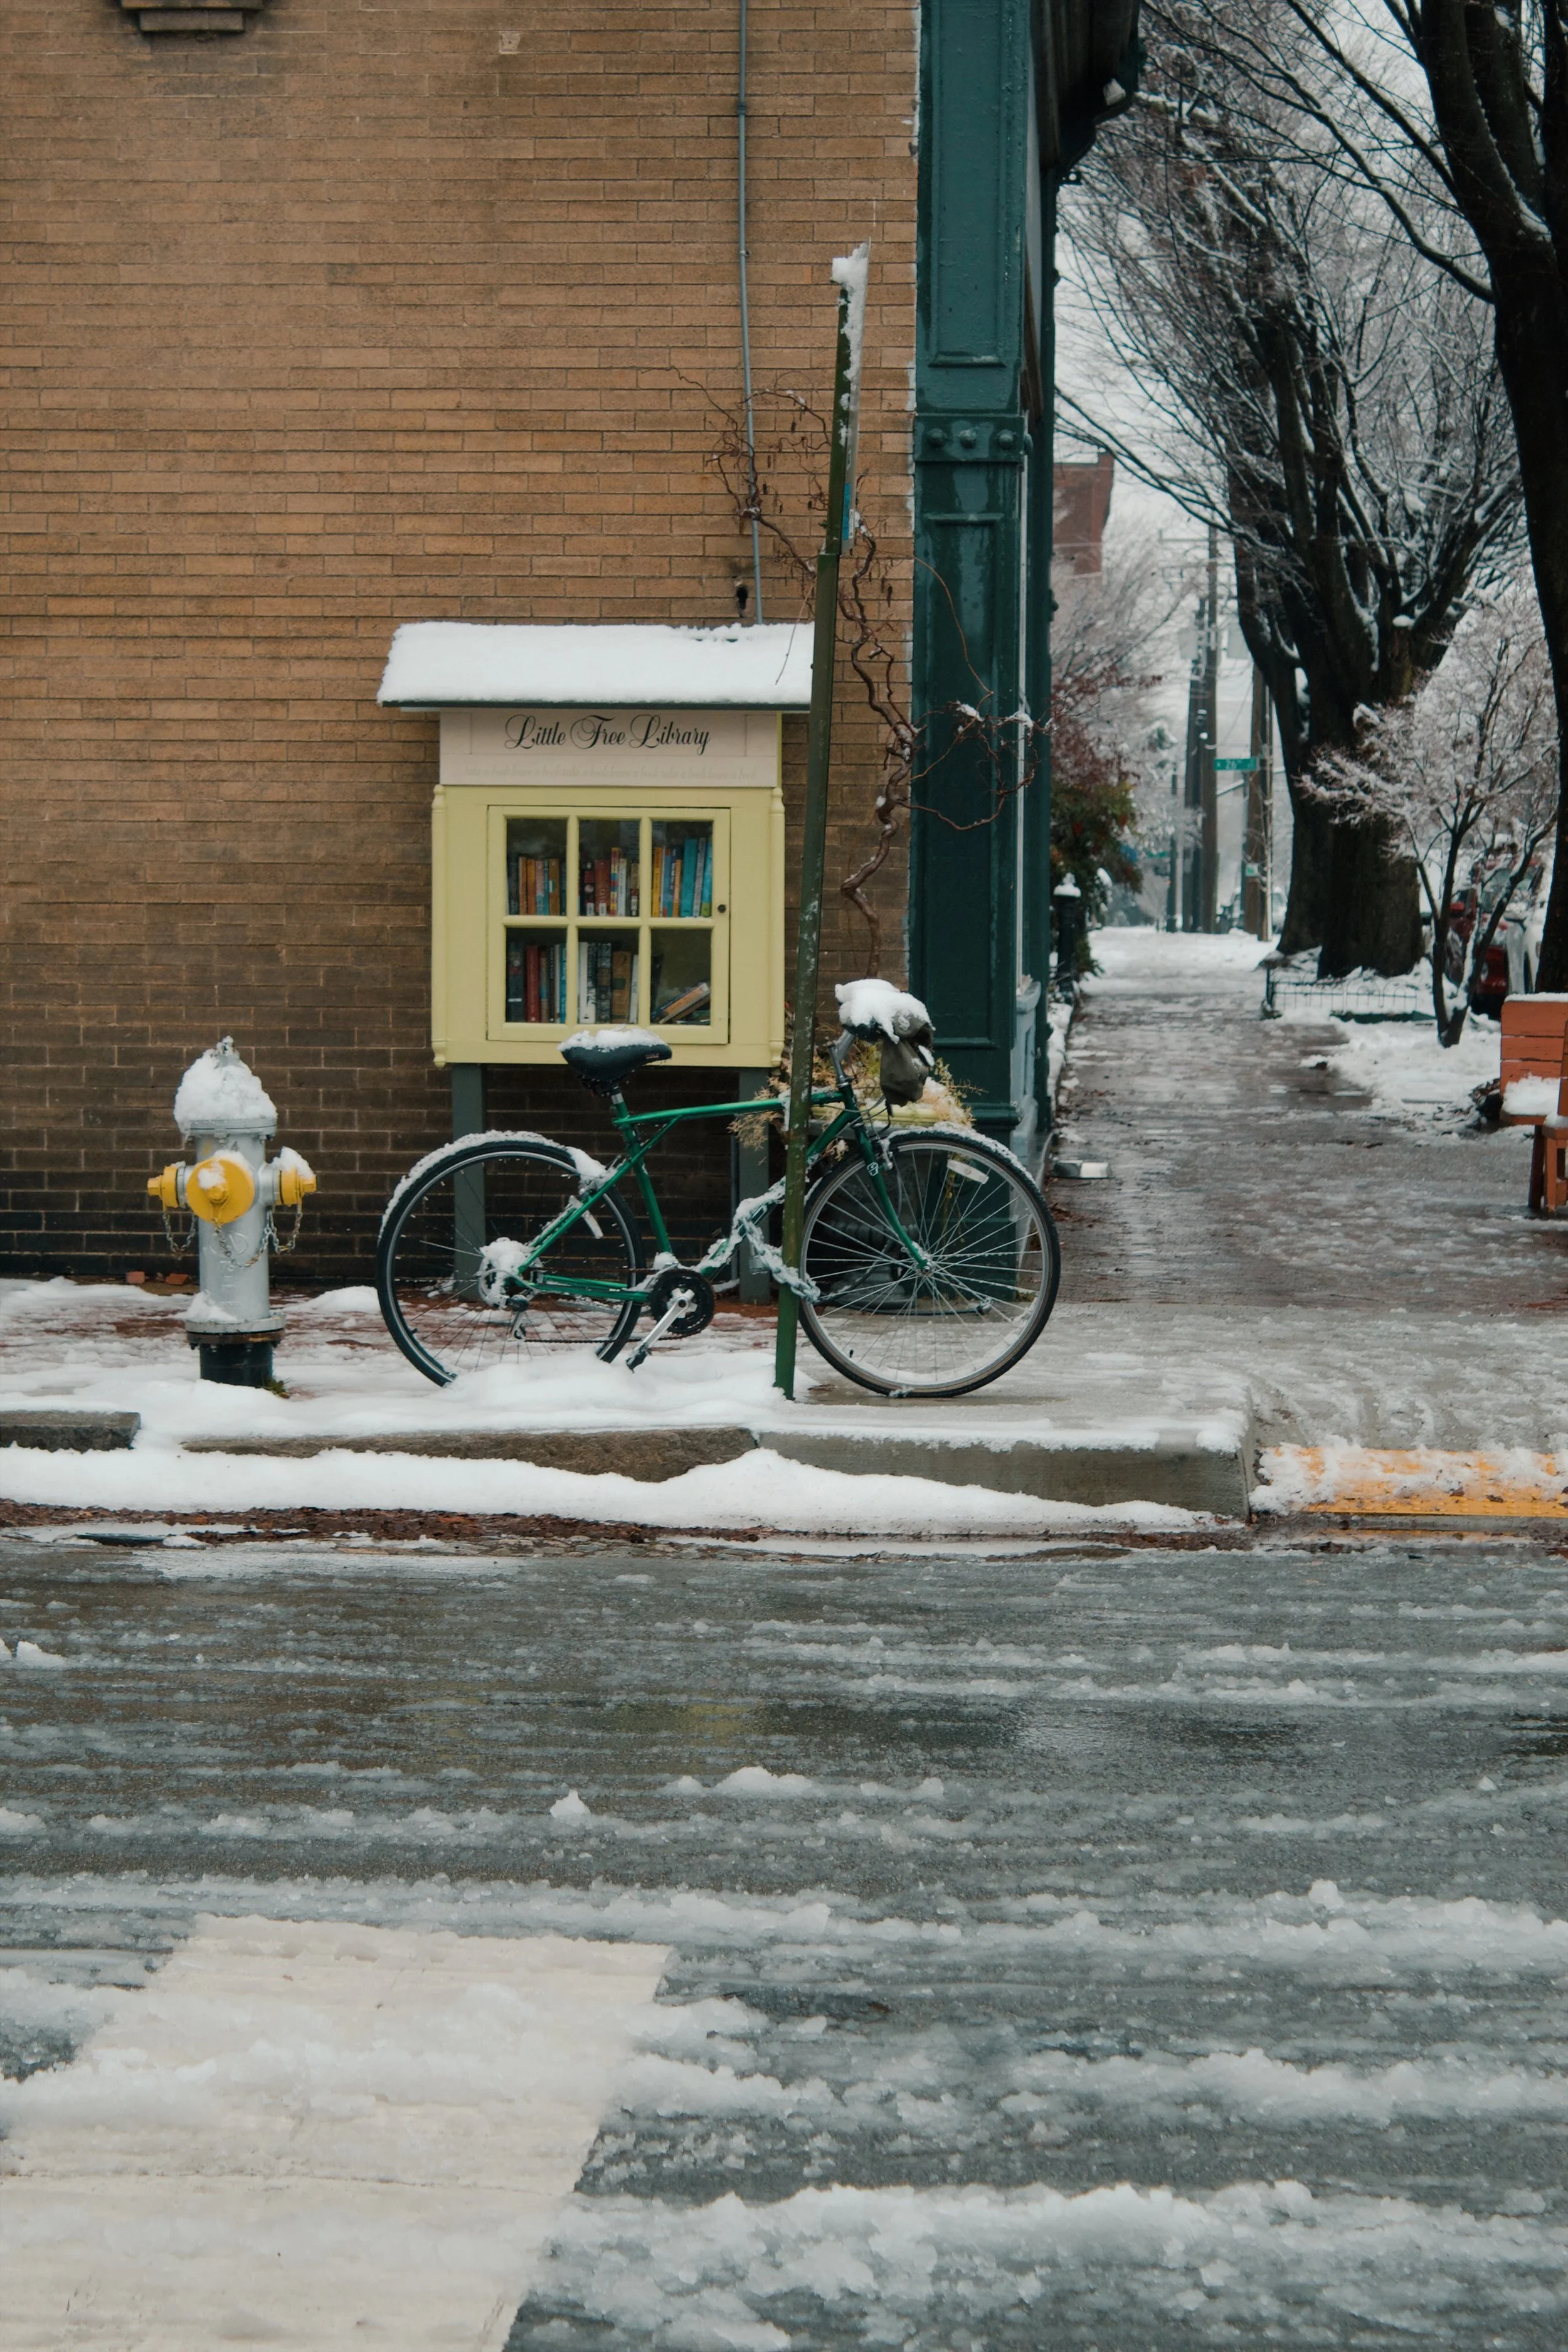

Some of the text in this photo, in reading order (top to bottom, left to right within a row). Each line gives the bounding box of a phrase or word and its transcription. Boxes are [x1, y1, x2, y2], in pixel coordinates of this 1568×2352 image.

[504, 714, 711, 756] Little Free Library
